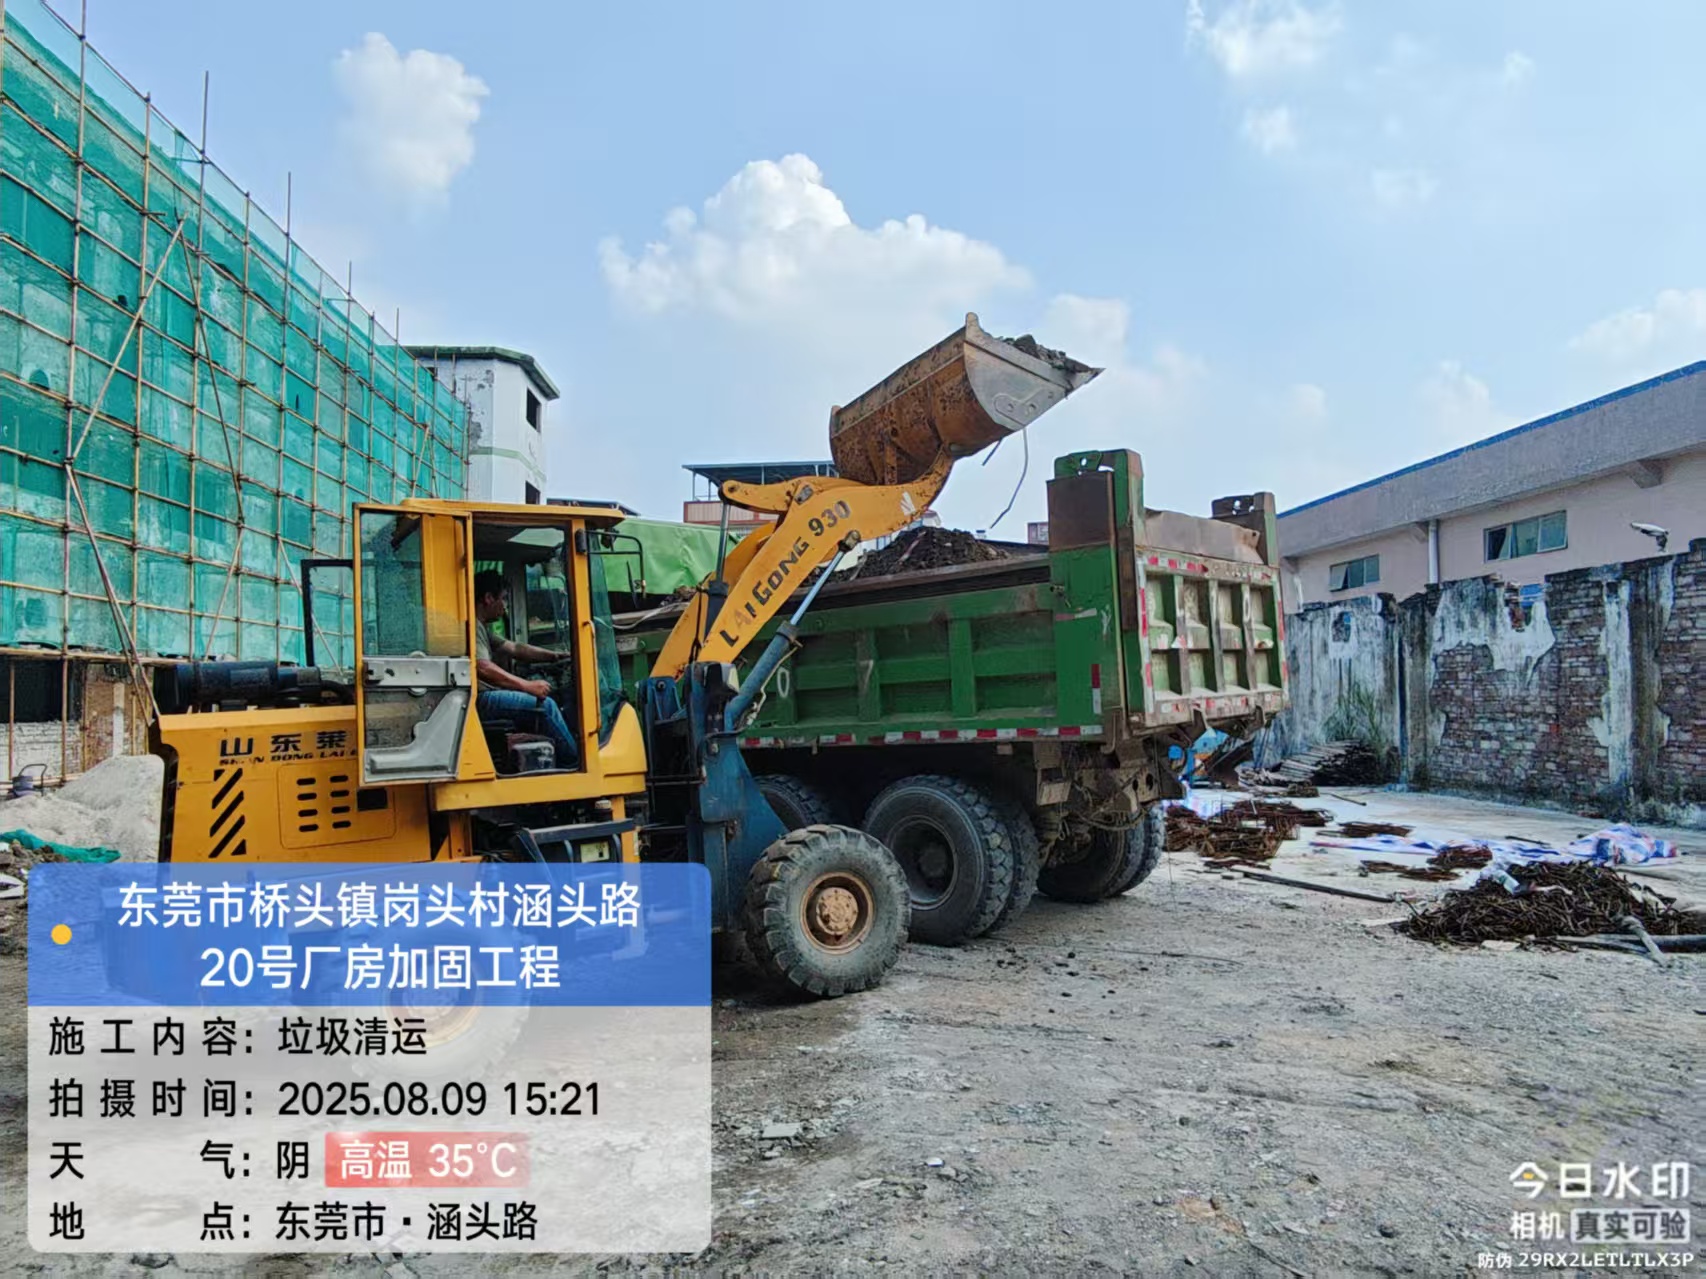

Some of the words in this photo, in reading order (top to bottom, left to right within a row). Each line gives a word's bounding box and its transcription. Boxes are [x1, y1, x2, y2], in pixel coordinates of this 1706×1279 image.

[807, 500, 852, 537] 930
[220, 730, 347, 757] 山东莱
[270, 752, 314, 762] DONG
